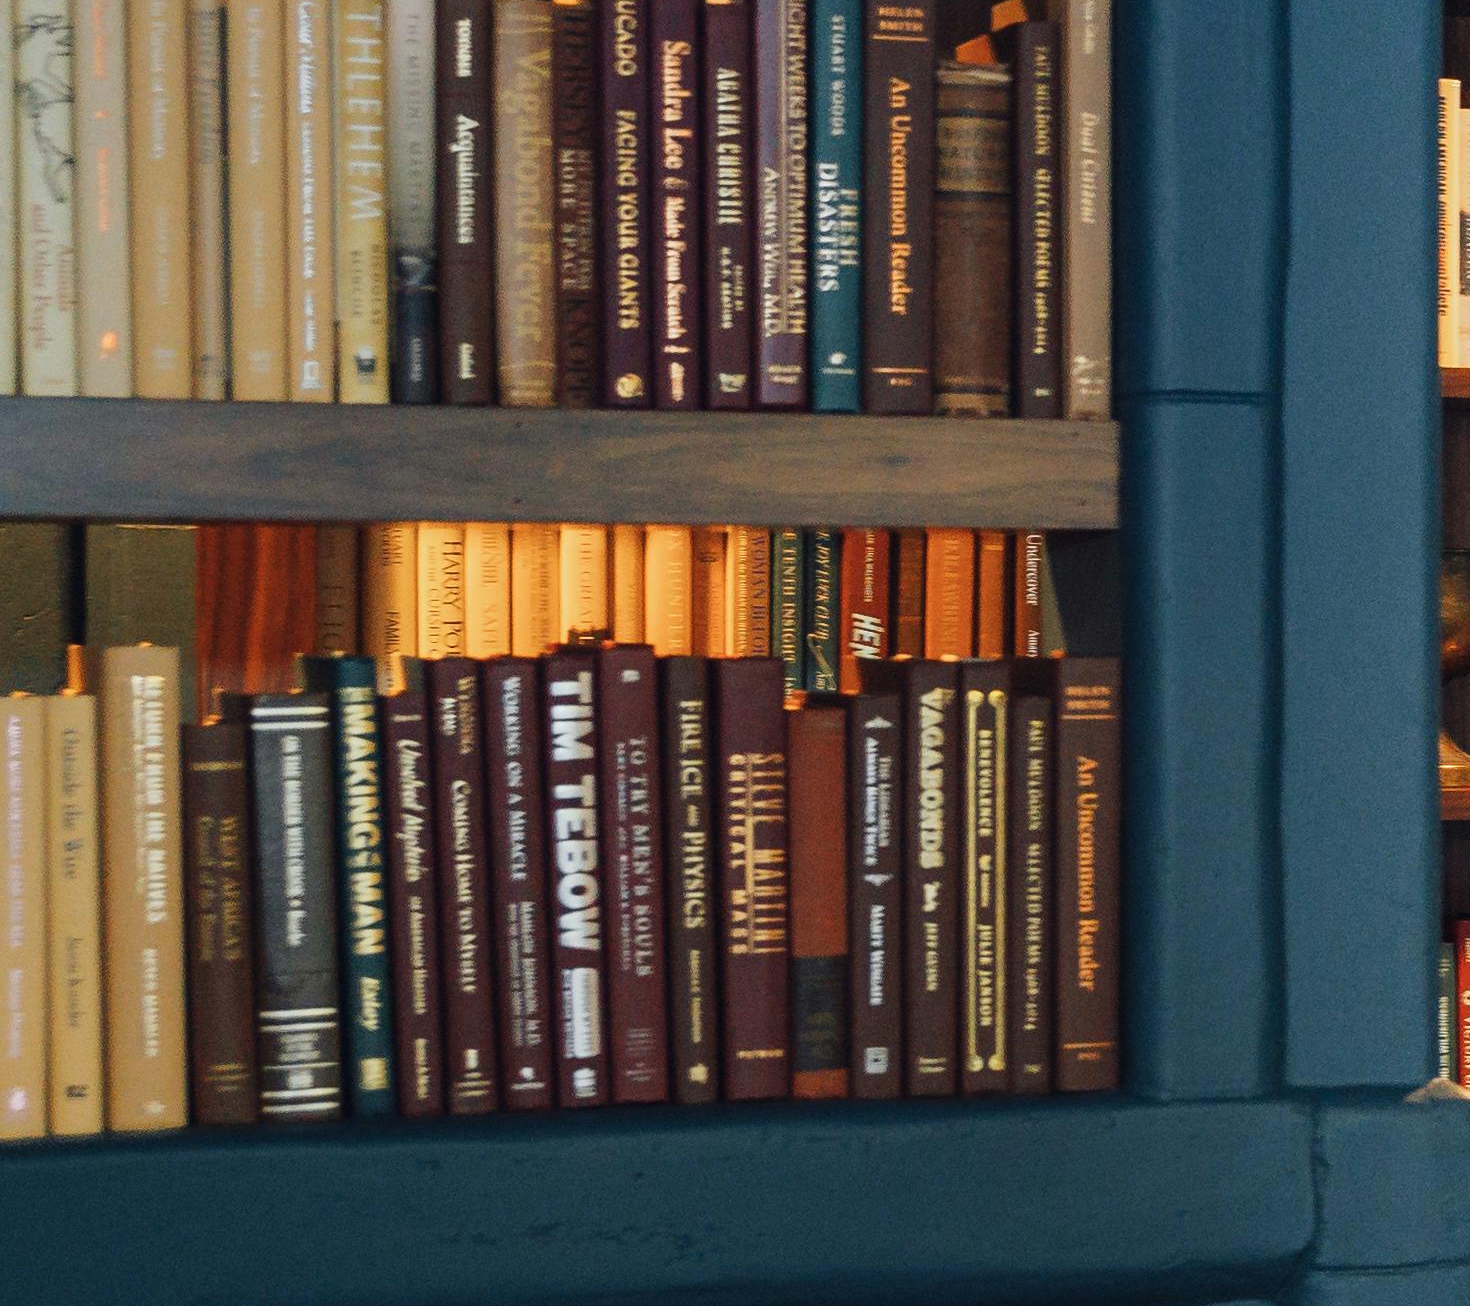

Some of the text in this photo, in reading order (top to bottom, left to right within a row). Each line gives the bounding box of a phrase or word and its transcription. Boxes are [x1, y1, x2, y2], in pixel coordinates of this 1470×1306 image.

[662, 40, 693, 169] Sandra Lee
[717, 67, 743, 225] AGATHA CHRISTIE
[788, 54, 805, 118] WEEKS
[788, 123, 805, 150] TO
[449, 114, 480, 244] Acquaintances
[504, 49, 552, 343] Vagabond Fever
[615, 109, 640, 330] FACING YOUR GIANTS
[788, 154, 806, 254] OPTIMUM
[818, 163, 840, 291] DISASTERS
[889, 77, 912, 316] An Uncommon Reader
[665, 196, 686, 339] Made From Scratch
[787, 259, 806, 334] HEALTH
[1026, 534, 1043, 606] Undercover
[503, 677, 524, 756] WORKING
[550, 670, 594, 762] TIM
[919, 689, 943, 868] VAGABONDS
[342, 704, 385, 955] MAKING MAN
[508, 811, 527, 881] MIRACLE
[552, 775, 600, 950] TEBOW
[629, 735, 655, 977] TO TRY MEN'S SOULS
[1076, 757, 1100, 992] An Uncommon Reader
